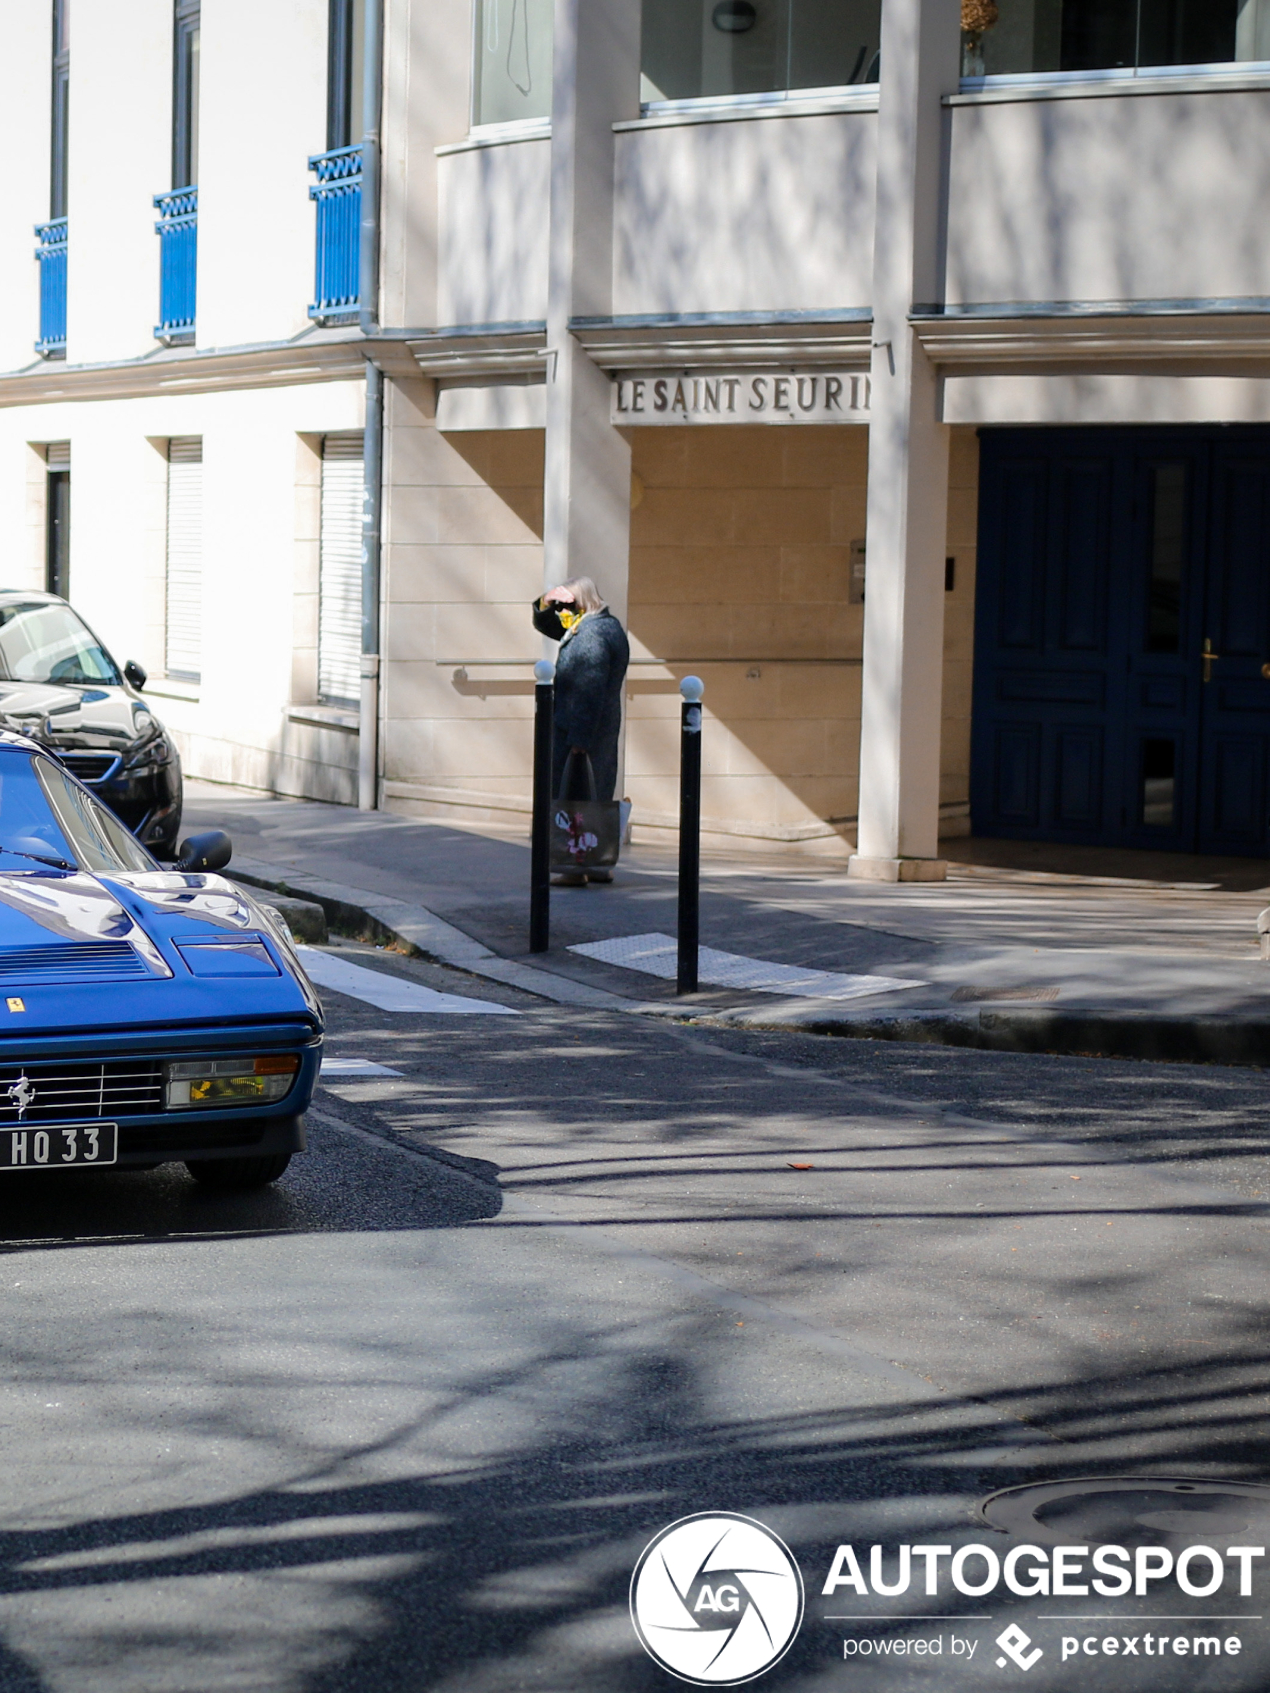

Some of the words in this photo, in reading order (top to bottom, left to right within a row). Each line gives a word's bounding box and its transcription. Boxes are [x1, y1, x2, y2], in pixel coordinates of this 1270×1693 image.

[613, 380, 645, 412] LE
[653, 378, 741, 412] SAINT
[11, 1131, 50, 1165] HQ
[61, 1128, 100, 1162] 33
